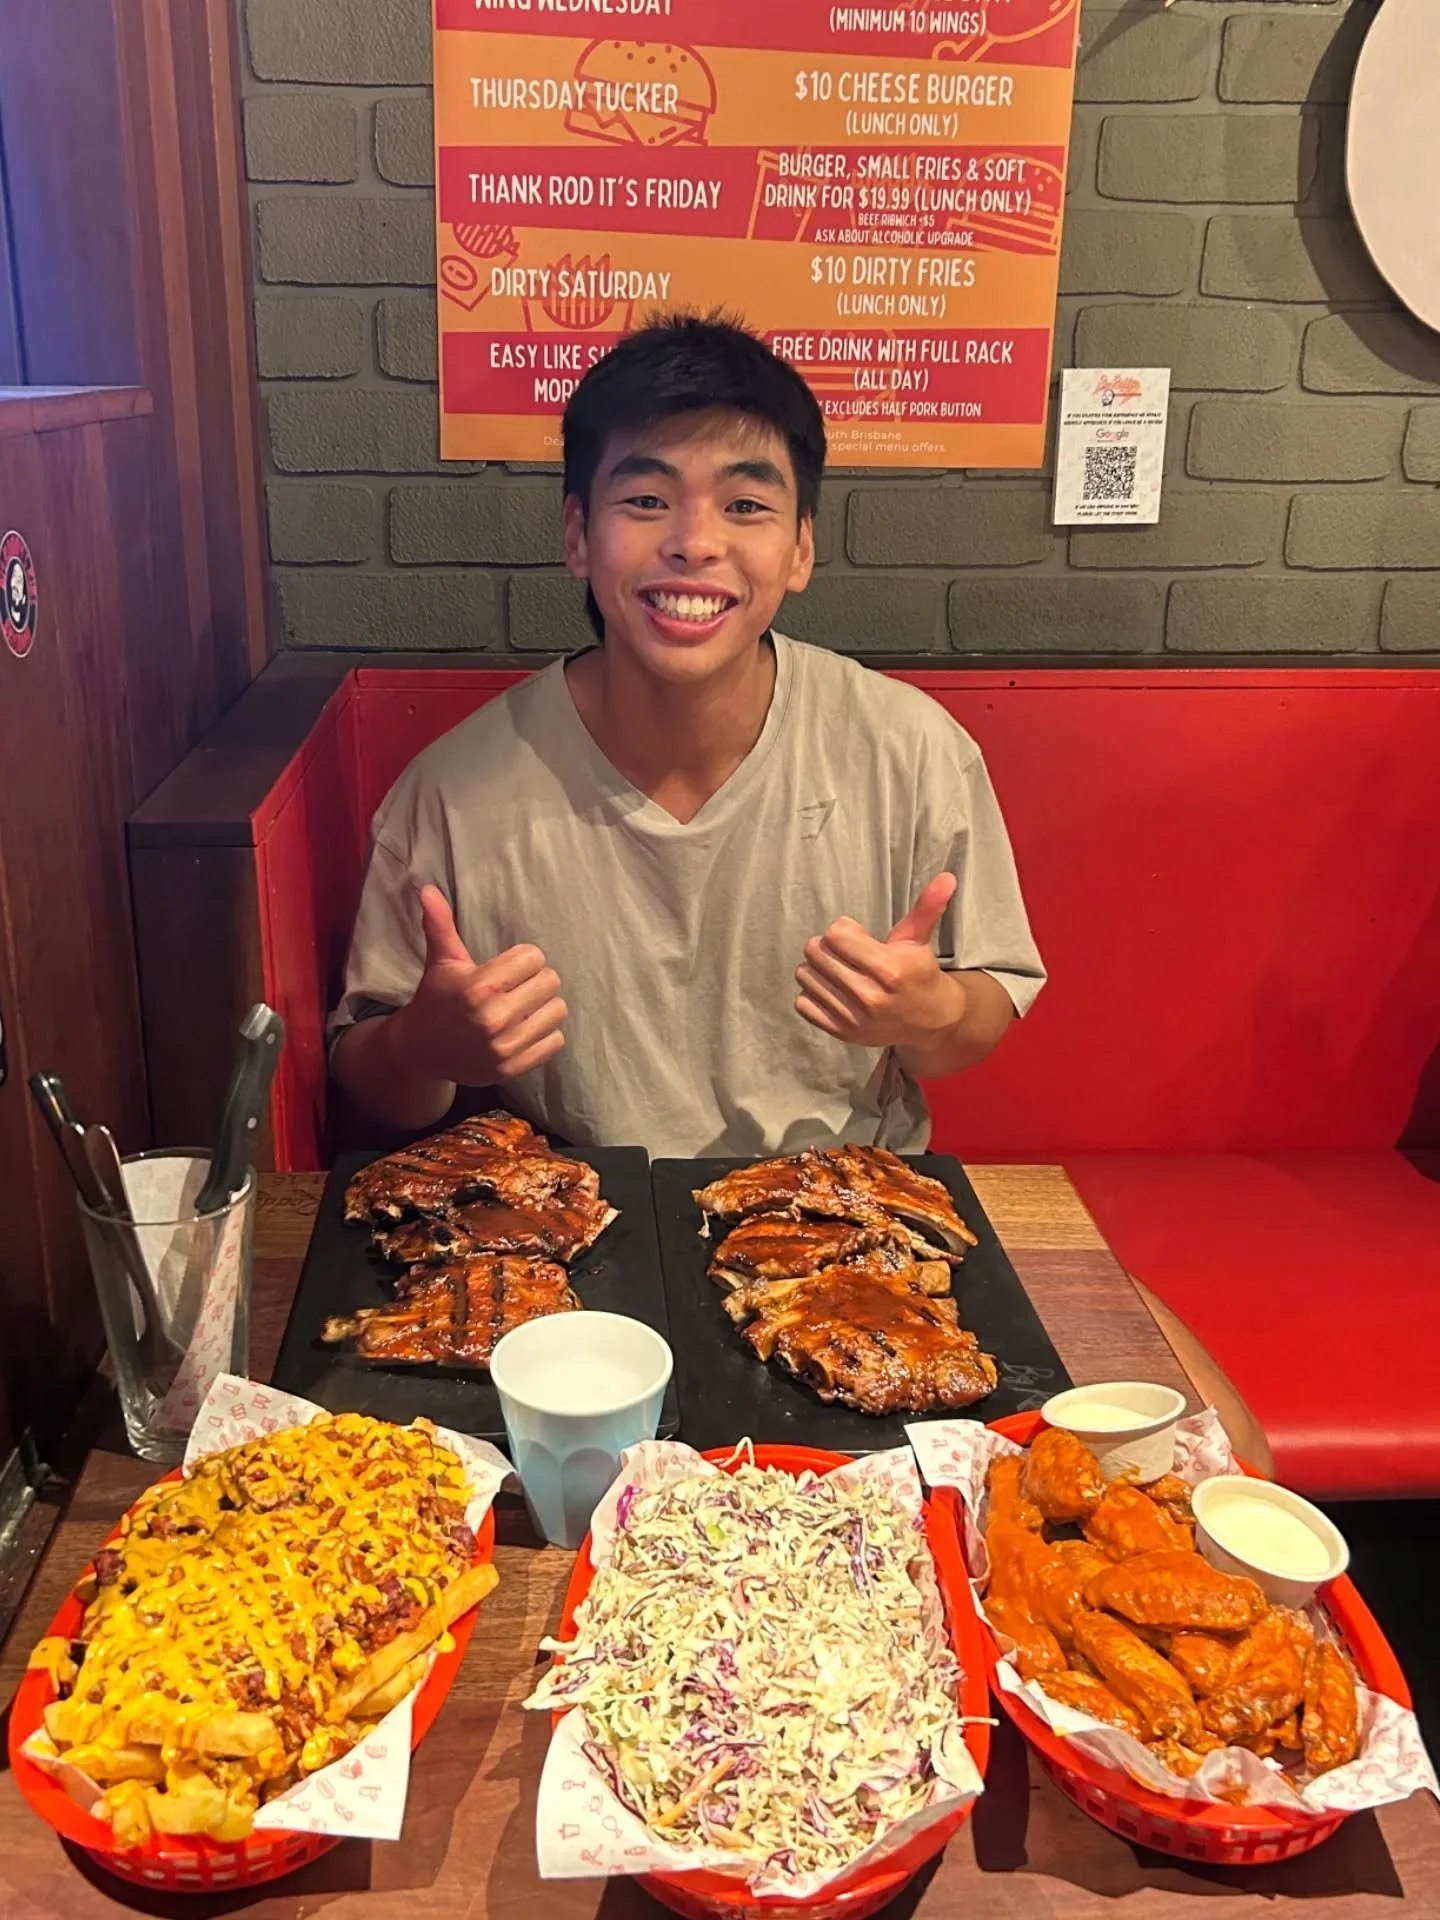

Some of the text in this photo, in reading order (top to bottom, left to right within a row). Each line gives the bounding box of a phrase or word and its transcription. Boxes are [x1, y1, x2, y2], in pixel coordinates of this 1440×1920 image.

[829, 8, 988, 37] (MINIMUM 10 WINGS)
[470, 77, 679, 114] THURSDAY TUCKER
[795, 71, 1014, 107] $10 CHEESE BURGER
[846, 109, 959, 139] (LUNCH ONLY)
[778, 152, 1026, 182] BURGER, SMALL FRIES & SOFT
[468, 173, 722, 210] THANK ROD IT'S FRIDAY
[765, 184, 1032, 215] DRINK FOR $19.99 (LUNCH ONLY)
[858, 213, 880, 226] BEEF
[815, 228, 974, 246] ASK ABOUT ALCOHOLIC UPGRADE
[491, 267, 672, 300] DIRTY SATURDAY
[810, 255, 976, 287] $10 DIRTY FRIES
[836, 291, 947, 319] (LUNCH ONLY)
[490, 342, 538, 369] EASY
[543, 344, 583, 370] LIKE
[772, 336, 1014, 364] FREE DRINK WITH FULL RACK
[853, 367, 929, 393] (ALL DAY)
[825, 400, 879, 416] EXCLUDES
[881, 400, 908, 417] HALF
[909, 401, 939, 417] PORK
[940, 402, 982, 418] BUTTON
[832, 441, 945, 453] special menu offers
[851, 429, 903, 441] Brisbane
[1096, 428, 1130, 441] Google
